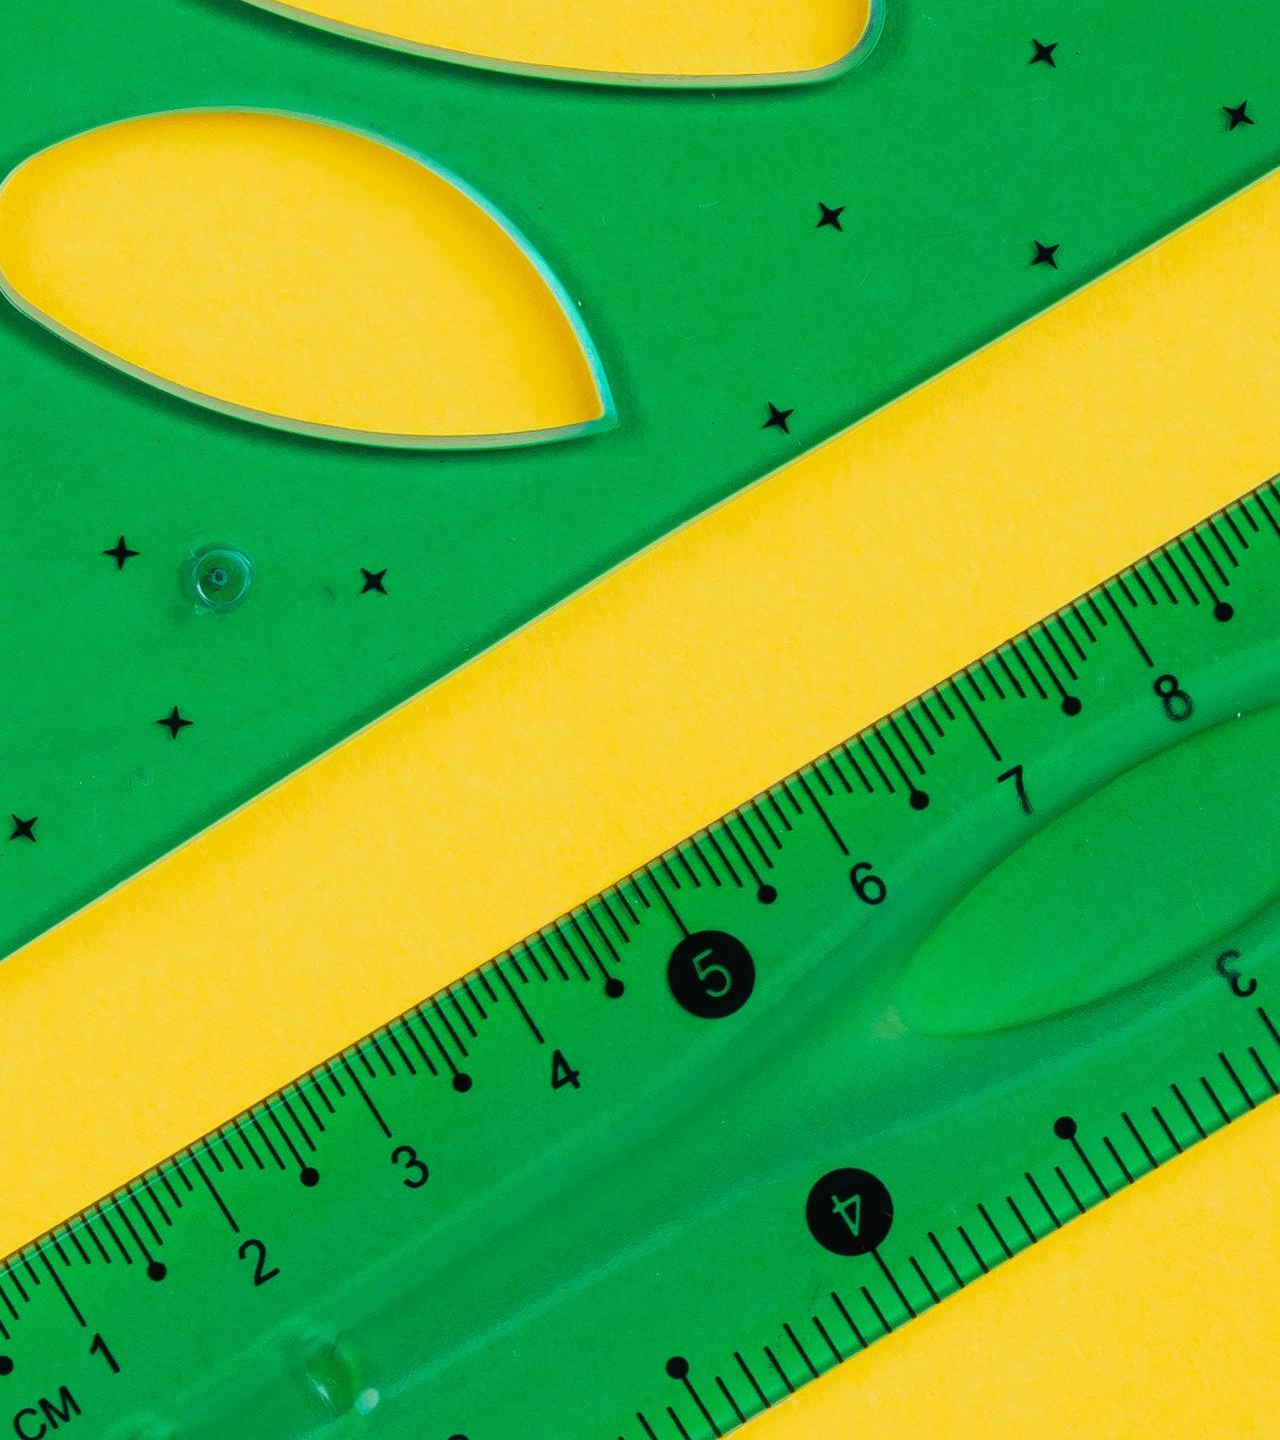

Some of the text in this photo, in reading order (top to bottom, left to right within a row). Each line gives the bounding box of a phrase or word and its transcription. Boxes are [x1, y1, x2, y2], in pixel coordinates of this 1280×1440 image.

[12, 672, 1194, 1440] CM 1 2 3 4 5 6 7 8
[830, 1192, 863, 1238] 4
